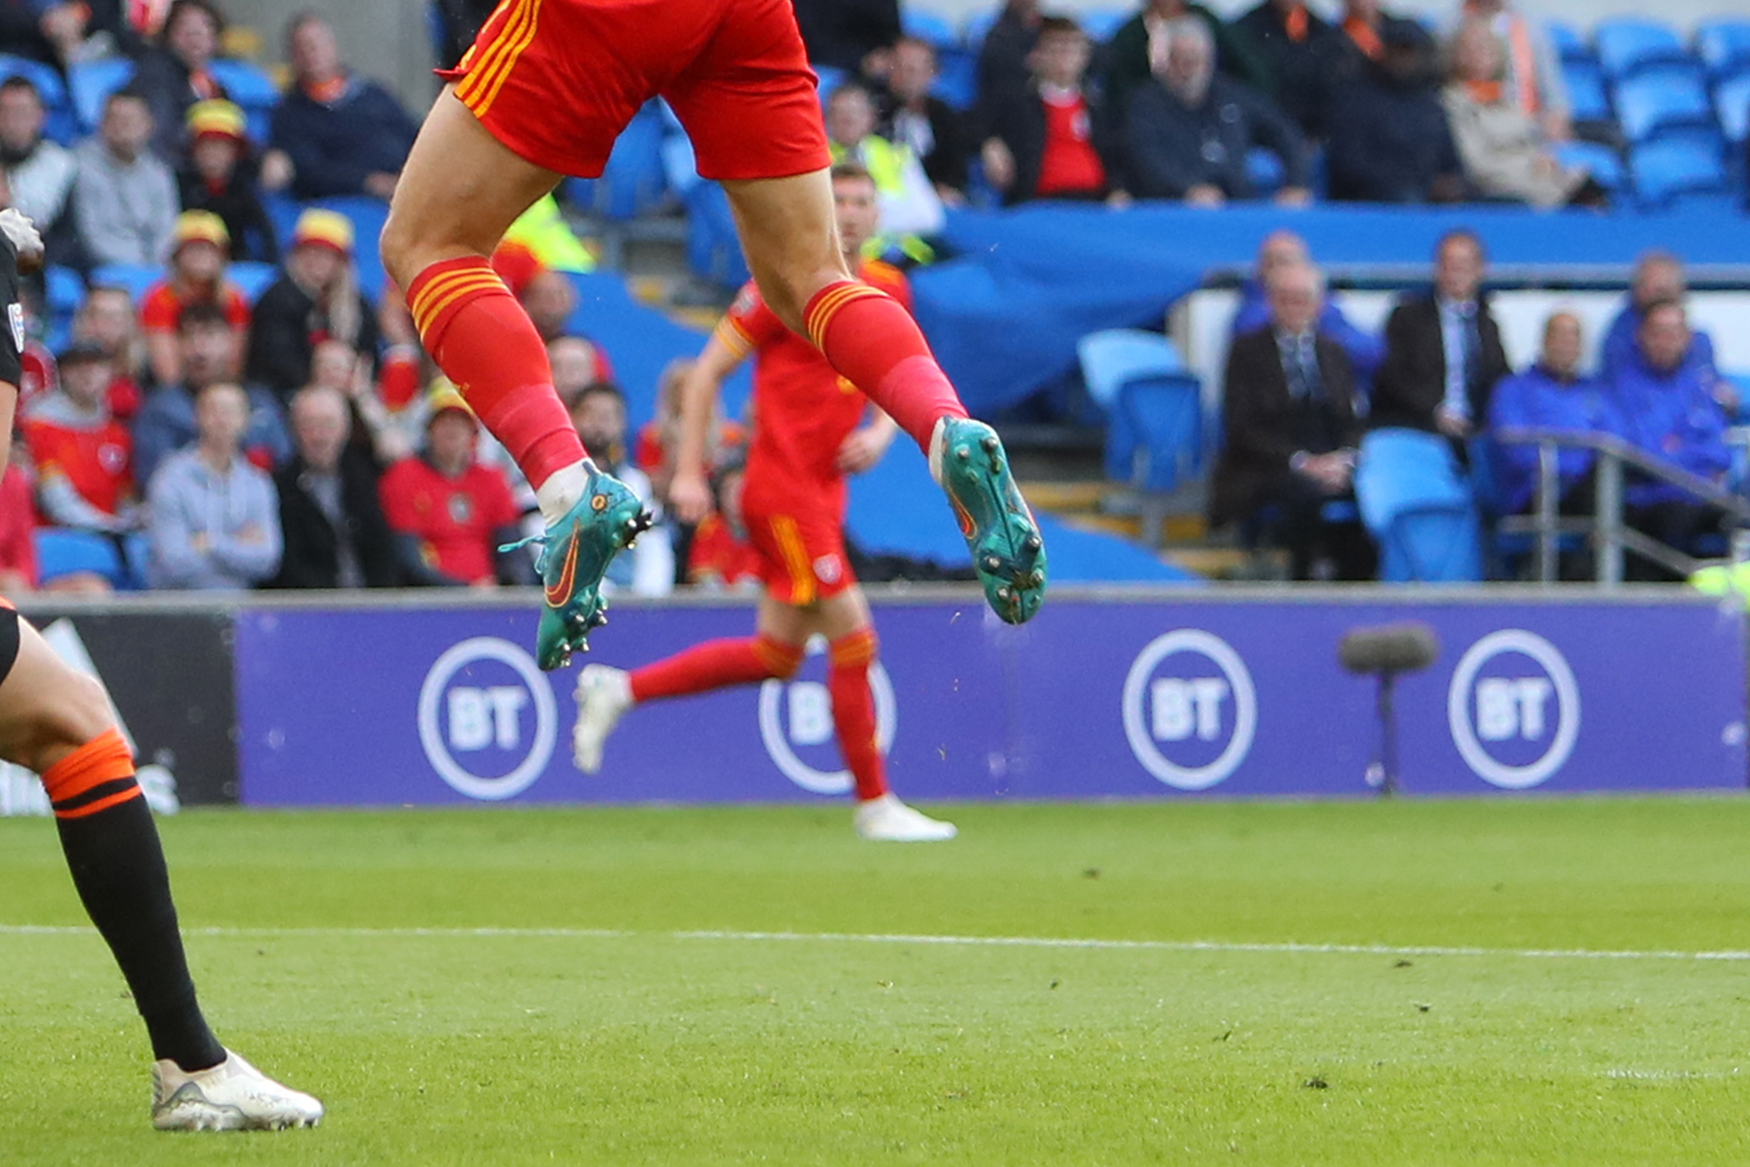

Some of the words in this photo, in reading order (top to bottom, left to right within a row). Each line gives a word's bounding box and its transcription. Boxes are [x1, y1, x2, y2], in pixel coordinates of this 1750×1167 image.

[448, 686, 528, 750] BT
[1151, 677, 1228, 741] BT
[1475, 677, 1551, 741] BT
